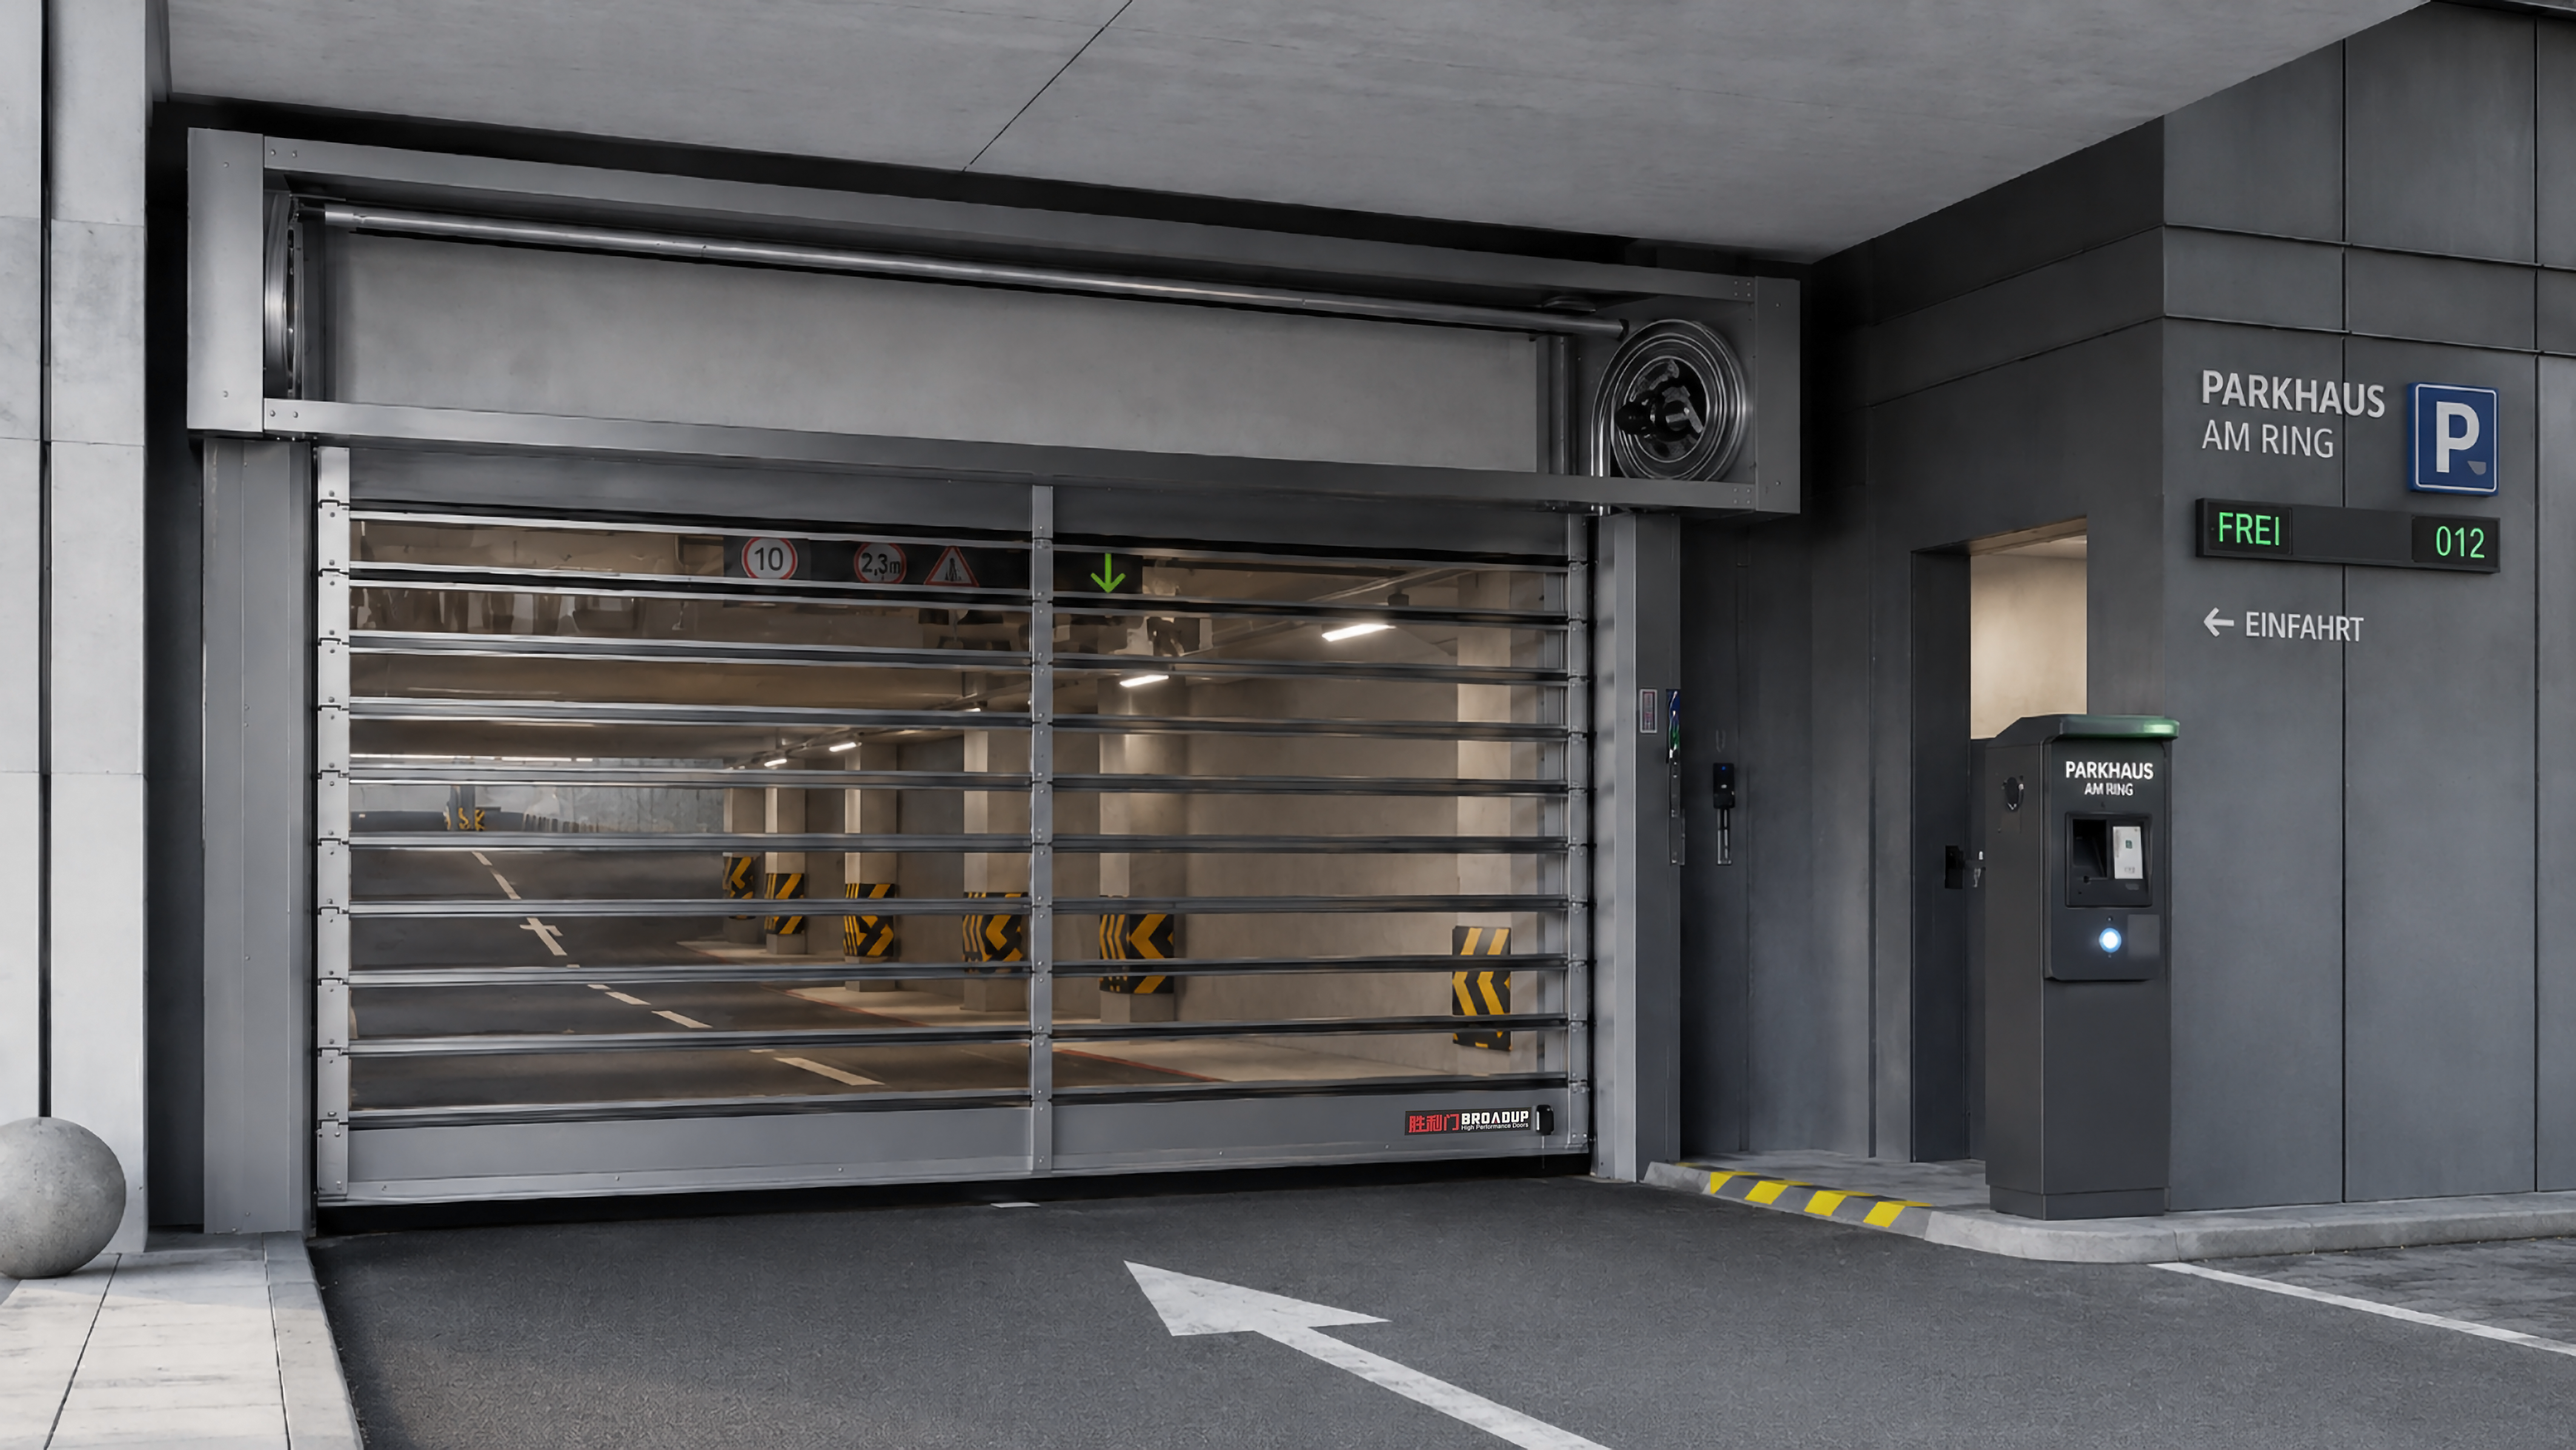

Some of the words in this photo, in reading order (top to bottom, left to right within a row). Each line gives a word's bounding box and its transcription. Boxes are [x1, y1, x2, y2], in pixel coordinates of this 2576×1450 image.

[2202, 370, 2386, 418] PARKHAUS
[2202, 419, 2250, 452] AM
[2261, 424, 2334, 458] RING
[2435, 401, 2480, 473] P
[2218, 511, 2280, 546] FREI
[2435, 525, 2486, 559] 012
[754, 547, 784, 571] 10
[2245, 611, 2365, 642] EINFAHRT
[2065, 761, 2154, 780] PARKHAUS
[2084, 783, 2103, 795] AM
[2105, 783, 2134, 796] RING
[1409, 1114, 1459, 1132] 胜利门
[1461, 1111, 1529, 1125] BROADUP
